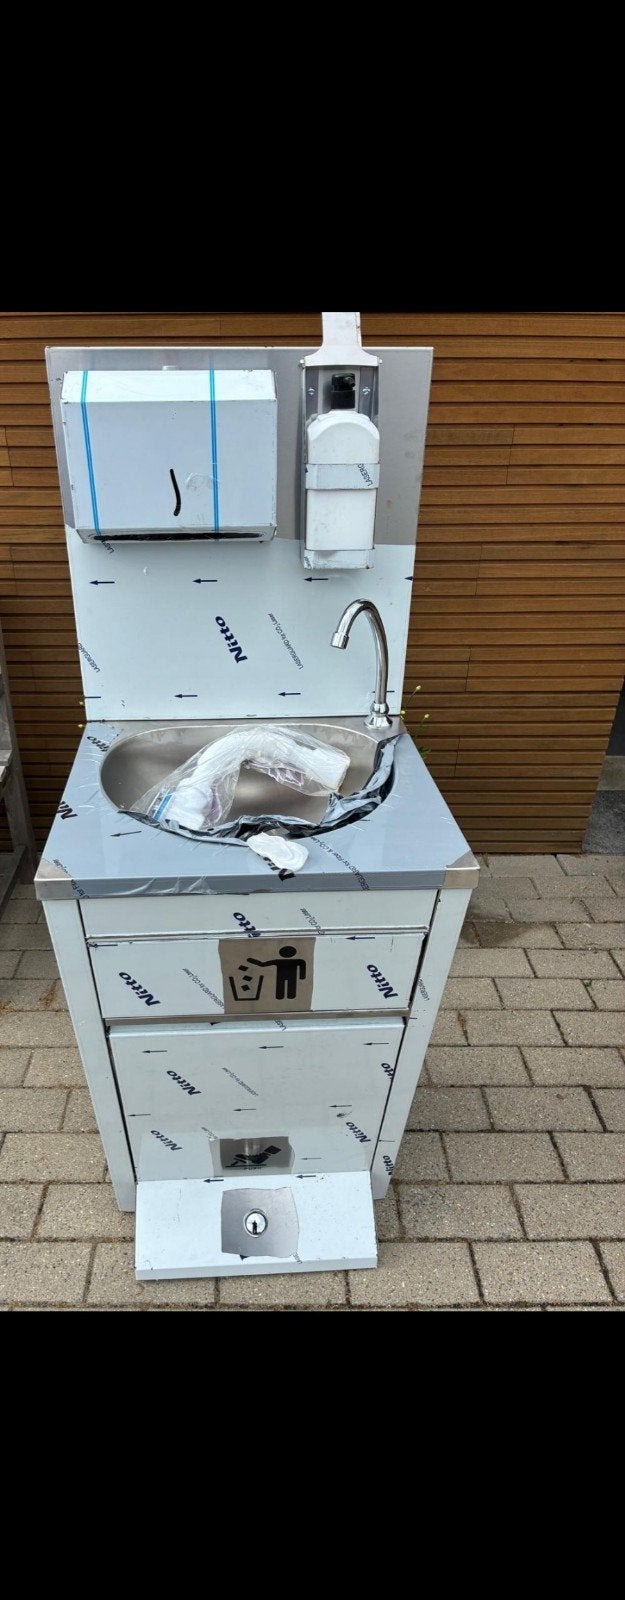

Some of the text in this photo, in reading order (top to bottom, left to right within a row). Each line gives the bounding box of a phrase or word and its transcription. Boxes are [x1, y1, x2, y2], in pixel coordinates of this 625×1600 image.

[215, 616, 248, 664] Nitto
[118, 972, 161, 1006] Nitto
[366, 964, 398, 999] Nitto
[166, 1070, 202, 1096] Nitto
[150, 1130, 182, 1151] Nitto
[346, 1121, 371, 1143] Nitto
